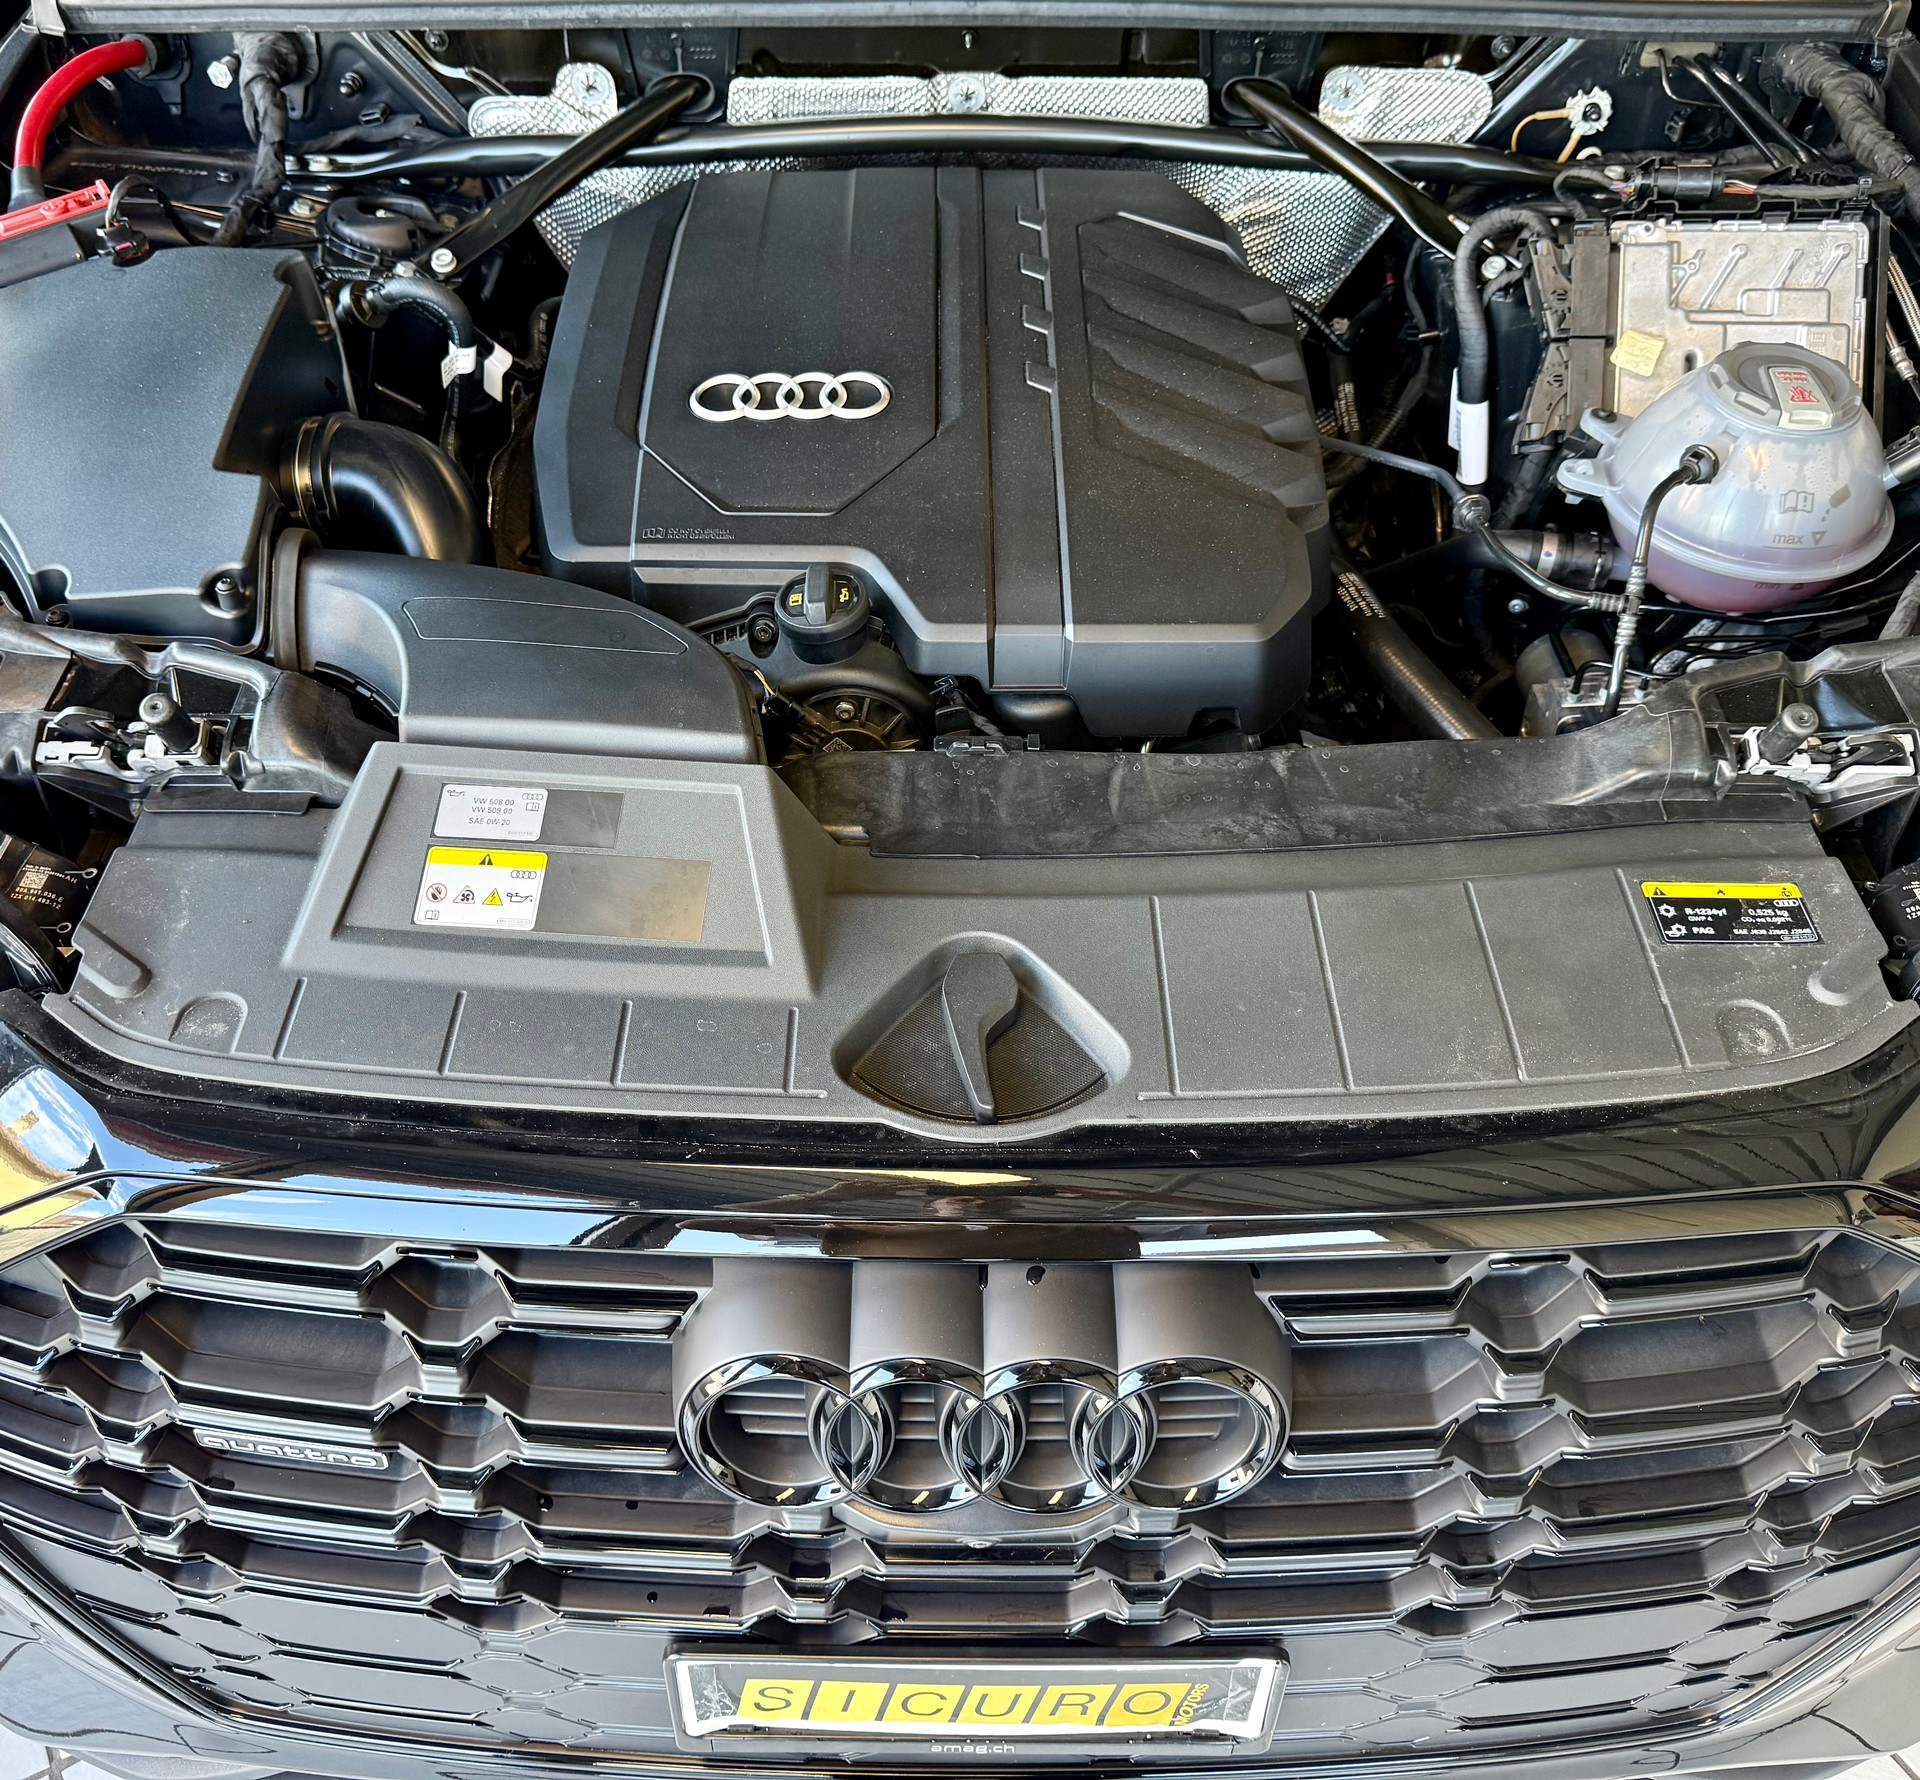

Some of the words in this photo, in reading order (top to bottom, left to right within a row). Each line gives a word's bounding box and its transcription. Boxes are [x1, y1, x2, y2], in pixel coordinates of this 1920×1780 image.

[1772, 534, 1804, 545] max
[473, 797, 487, 805] VW
[489, 798, 503, 806] 508
[487, 806, 501, 814] 509
[503, 807, 513, 815] 00
[468, 817, 484, 825] SAE
[486, 818, 511, 826] 0W-20
[202, 1436, 377, 1467] quattro
[753, 1686, 1172, 1717] SICURO
[1172, 1683, 1210, 1726] MOTORS
[931, 1743, 1015, 1754] amag.ch
